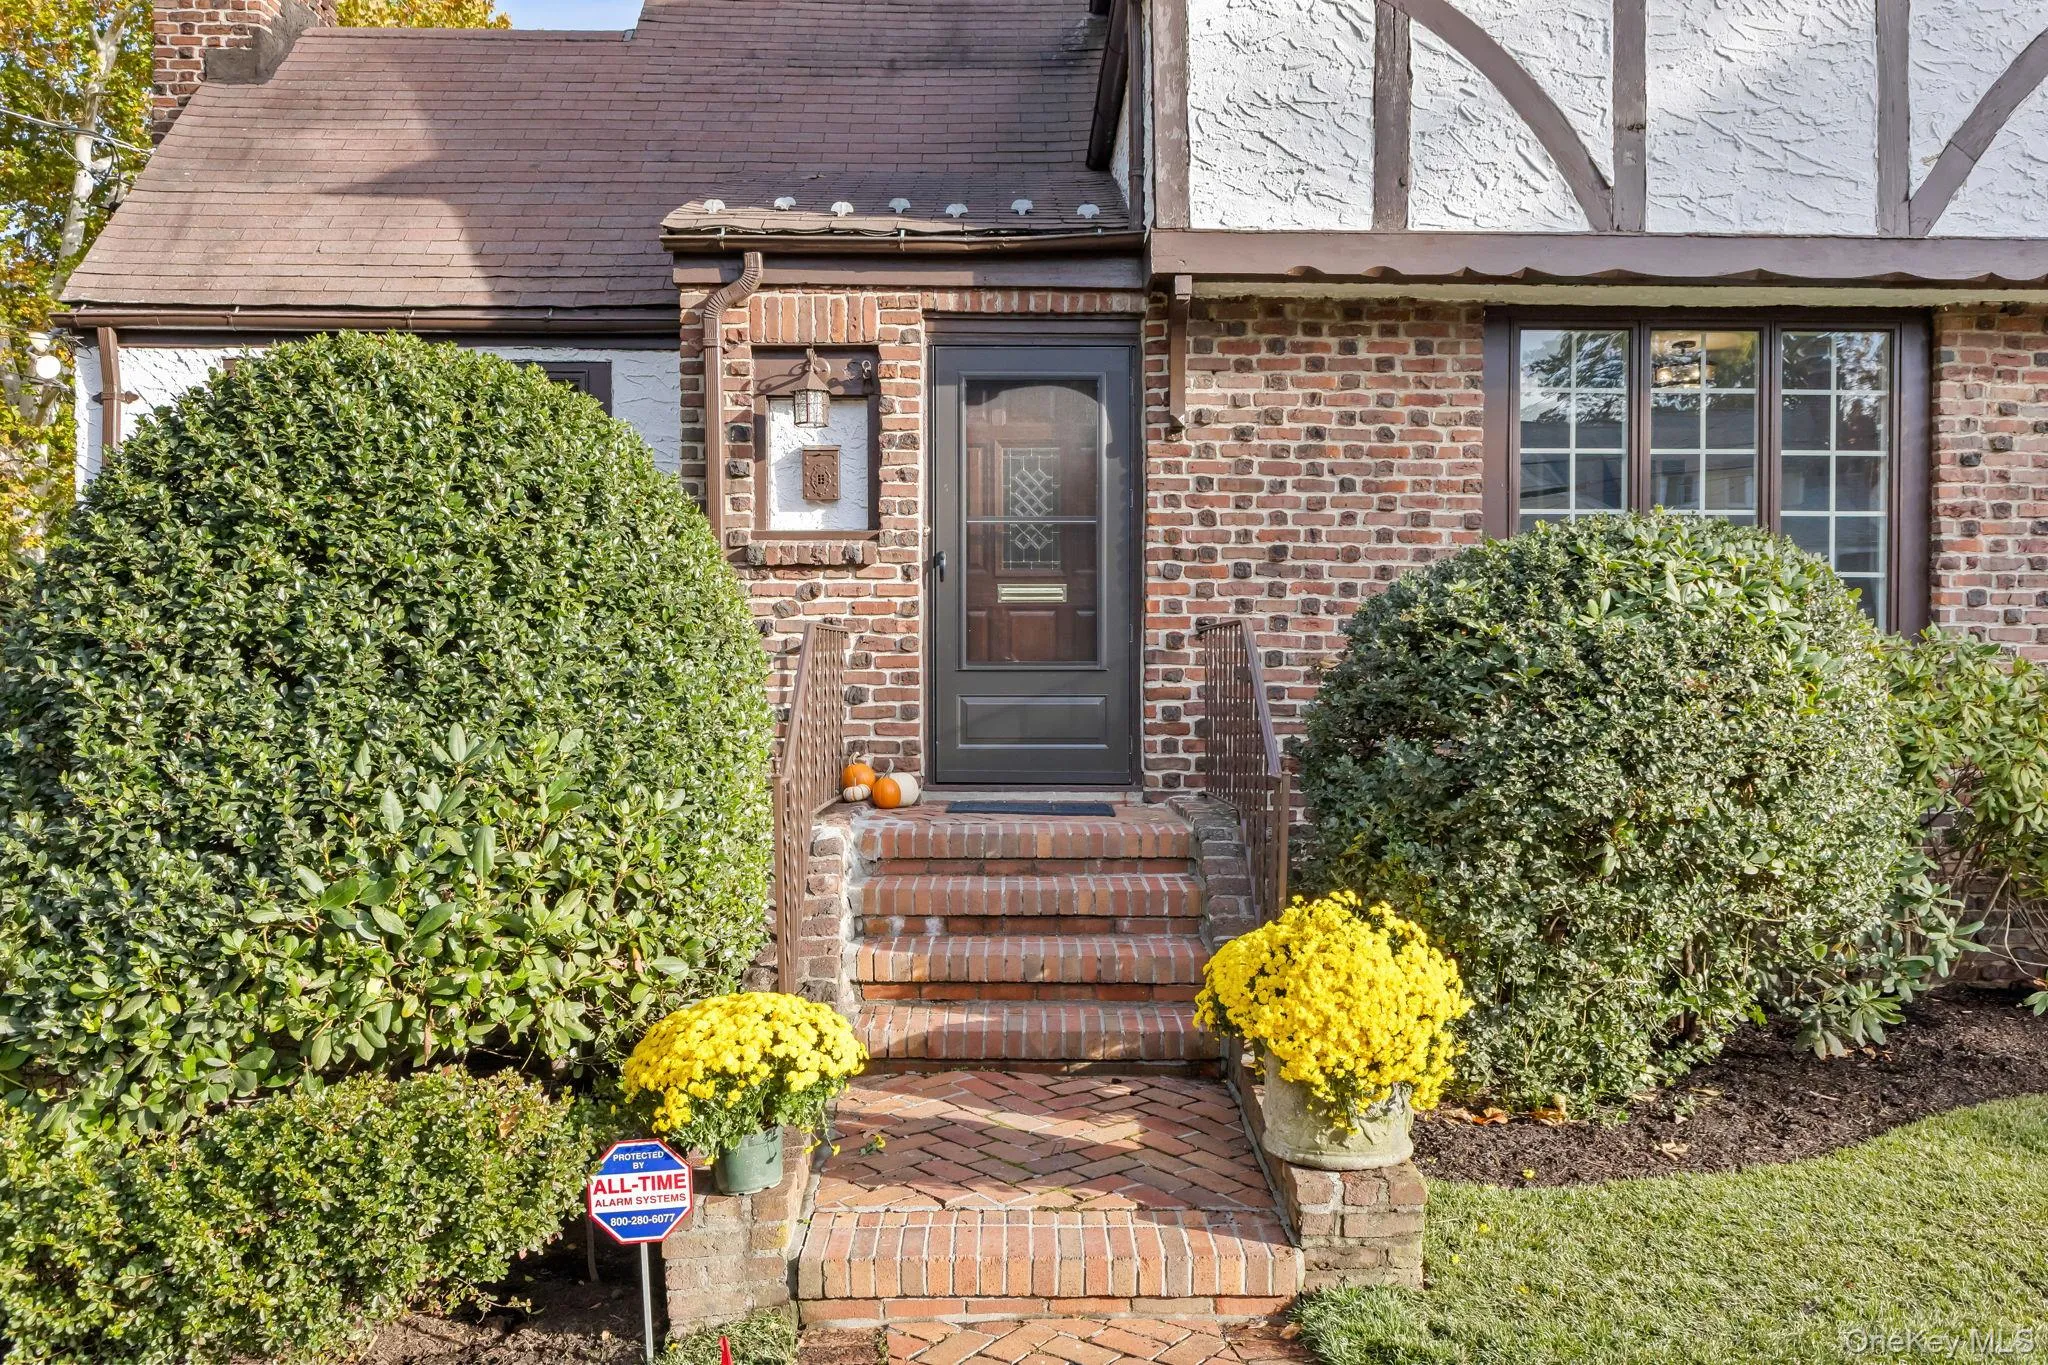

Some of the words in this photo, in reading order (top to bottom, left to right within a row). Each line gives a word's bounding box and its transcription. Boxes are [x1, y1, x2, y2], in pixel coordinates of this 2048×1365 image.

[613, 1151, 664, 1162] PROTECTED
[593, 1173, 687, 1195] ALL-TIME
[595, 1199, 633, 1208] ALARM
[635, 1193, 686, 1205] SYSTEMS
[610, 1213, 675, 1227] 800-280-6077
